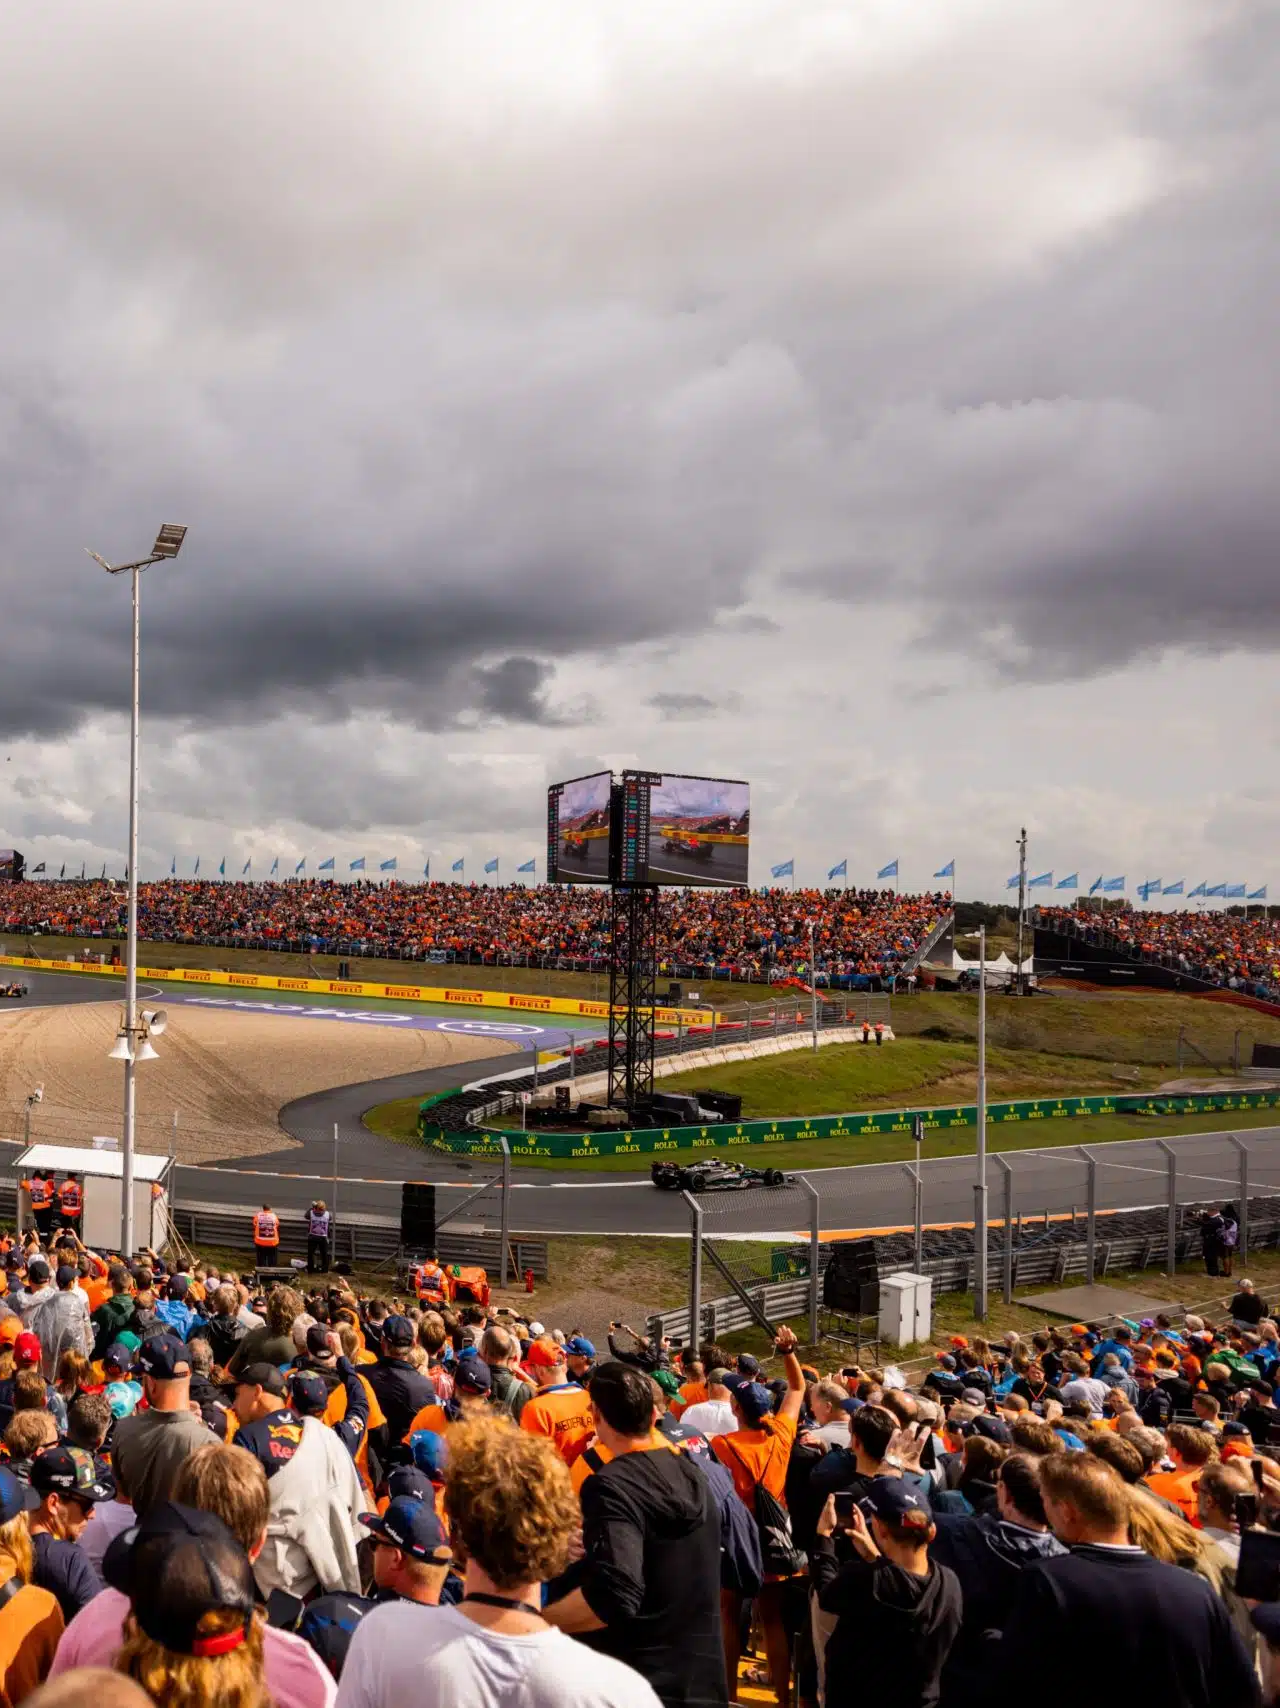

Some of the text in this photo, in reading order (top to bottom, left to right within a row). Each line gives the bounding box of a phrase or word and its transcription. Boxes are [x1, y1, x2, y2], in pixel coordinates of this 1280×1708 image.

[183, 971, 211, 981] PIRELLI
[228, 975, 258, 985] PIRELLI
[277, 979, 308, 990] PIRELLI
[329, 983, 362, 993] PIRELLI
[385, 986, 420, 999] PIRELLI
[445, 990, 484, 1003] PIRELLI
[509, 996, 551, 1009] PIRELLI
[830, 1128, 849, 1136] ROLEX
[860, 1125, 880, 1133] ROLEX
[763, 1133, 785, 1142] ROLEX
[796, 1131, 818, 1139] ROLEX
[654, 1140, 678, 1150] ROLEX
[692, 1139, 716, 1147] ROLEX
[728, 1136, 750, 1145] ROLEX
[471, 1145, 502, 1153] ROLEX
[513, 1146, 552, 1156] ROLEX
[572, 1147, 599, 1156] ROLEX
[615, 1144, 640, 1153] ROLEX
[555, 1416, 593, 1432] NEDERLA
